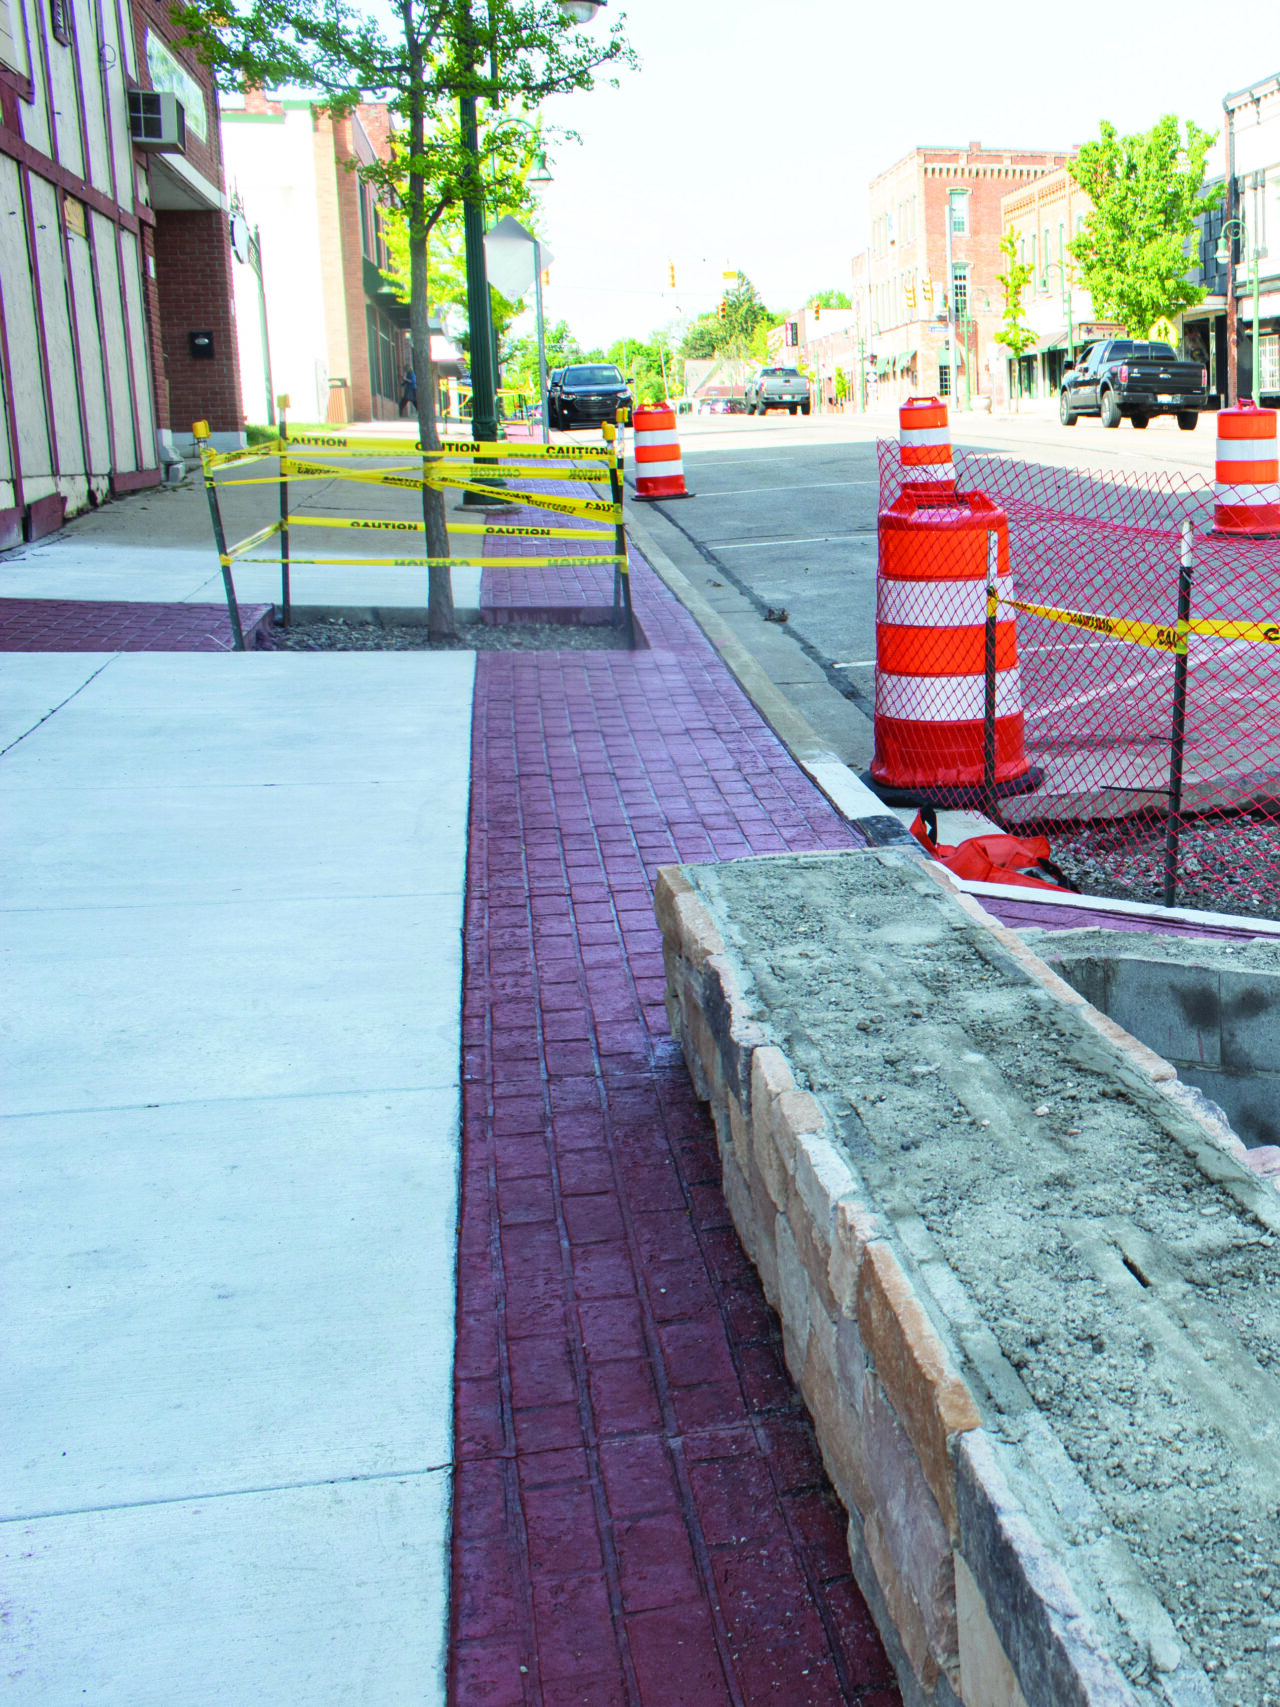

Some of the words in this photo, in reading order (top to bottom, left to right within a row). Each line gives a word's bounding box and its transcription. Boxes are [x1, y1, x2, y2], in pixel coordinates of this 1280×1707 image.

[286, 437, 347, 447] AUTION
[415, 441, 480, 452] CTION
[350, 521, 418, 530] CAUTION
[485, 526, 551, 535] CAUTION
